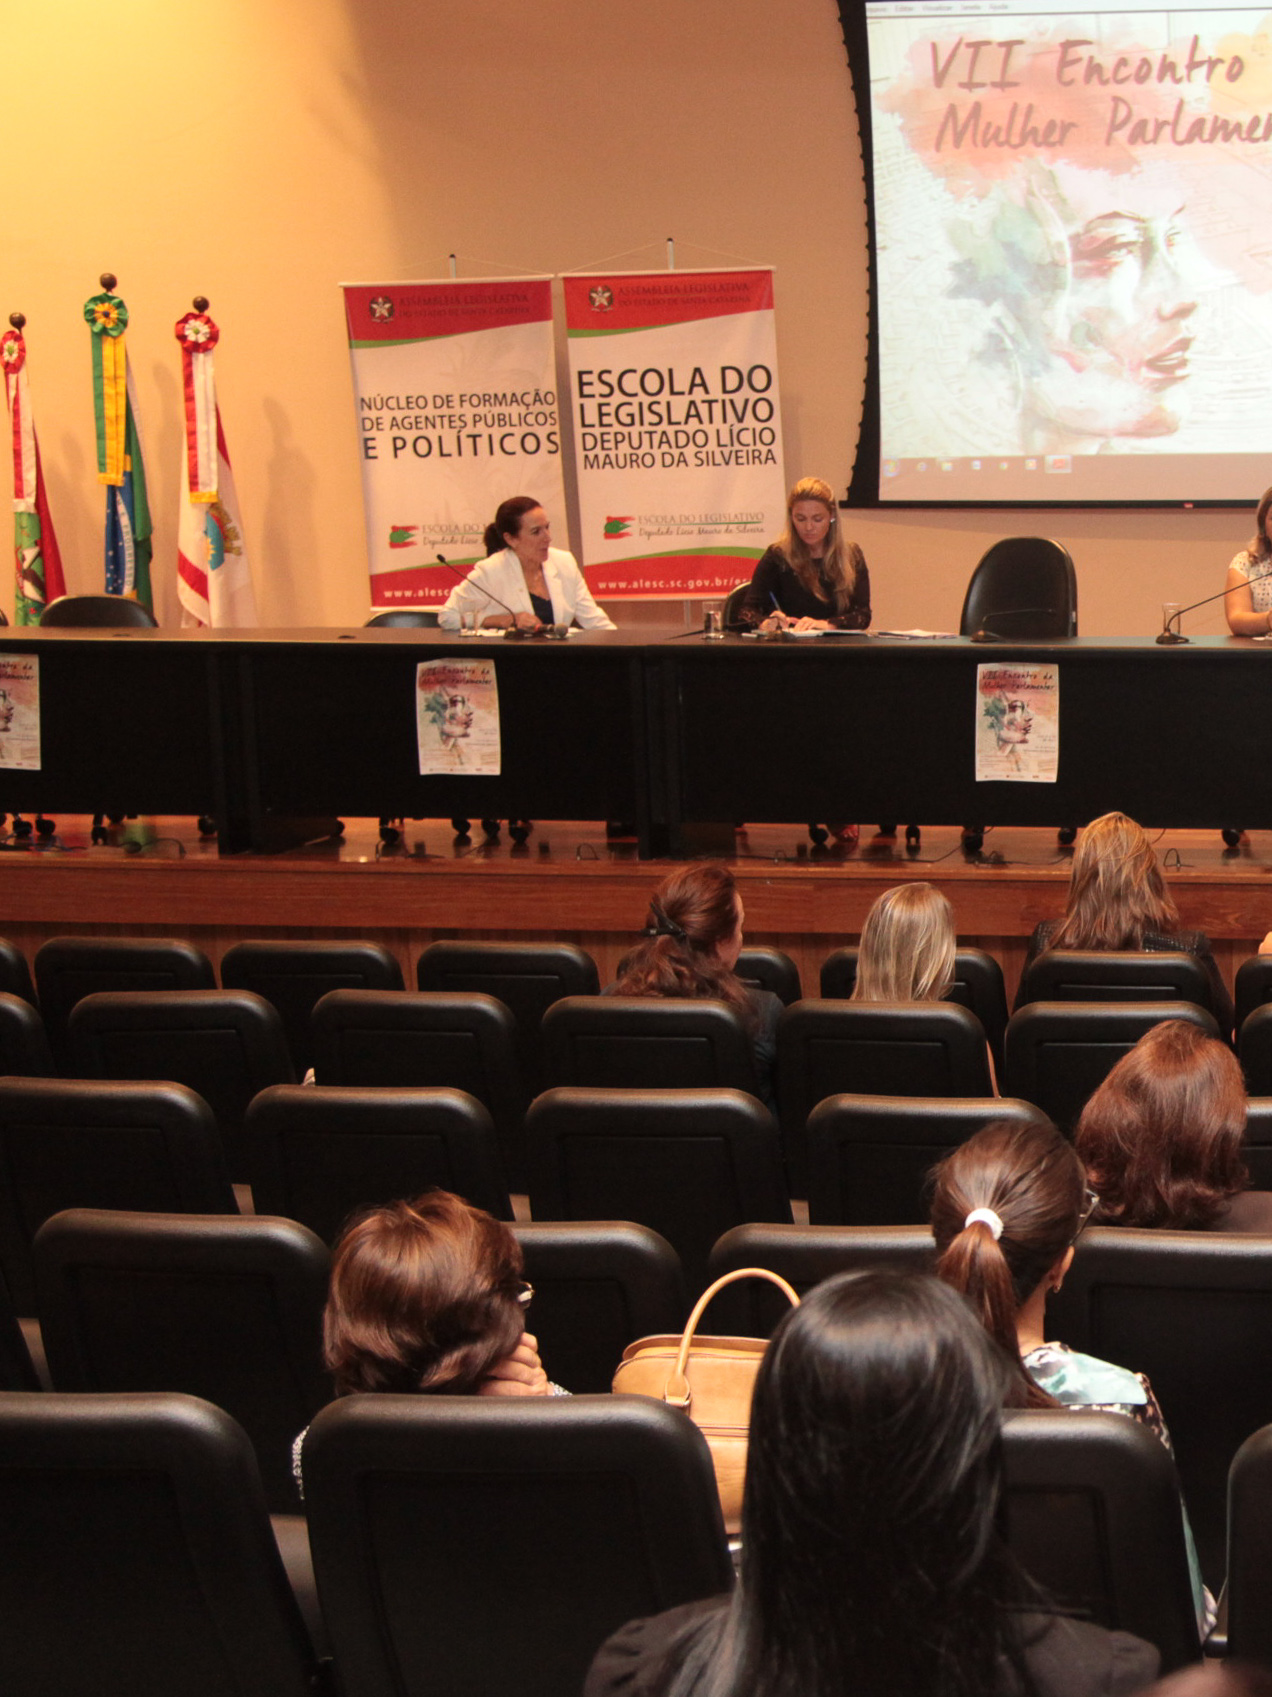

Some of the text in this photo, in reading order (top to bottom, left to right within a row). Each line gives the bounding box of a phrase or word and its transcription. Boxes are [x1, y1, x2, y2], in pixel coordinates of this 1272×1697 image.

[930, 36, 1025, 93] VII
[1056, 34, 1245, 87] Encontro
[934, 100, 1079, 152] Mulher
[577, 364, 772, 398] ESCOLA DO
[360, 389, 556, 411] NÚCLEO DE FORMAÇÃO
[579, 397, 775, 428] LEGISLATIVO
[361, 411, 557, 432] DE AGENTES PÚBLICOS
[363, 430, 560, 460] E POLÍTICOS
[581, 424, 776, 451] DEPUTADO LÍCIO
[583, 449, 777, 470] MAURO DA SILVEIRA
[422, 523, 460, 533] ESCOLA
[463, 523, 479, 533] DO
[638, 511, 764, 524] ESCOLA DO LEGISLATIVO
